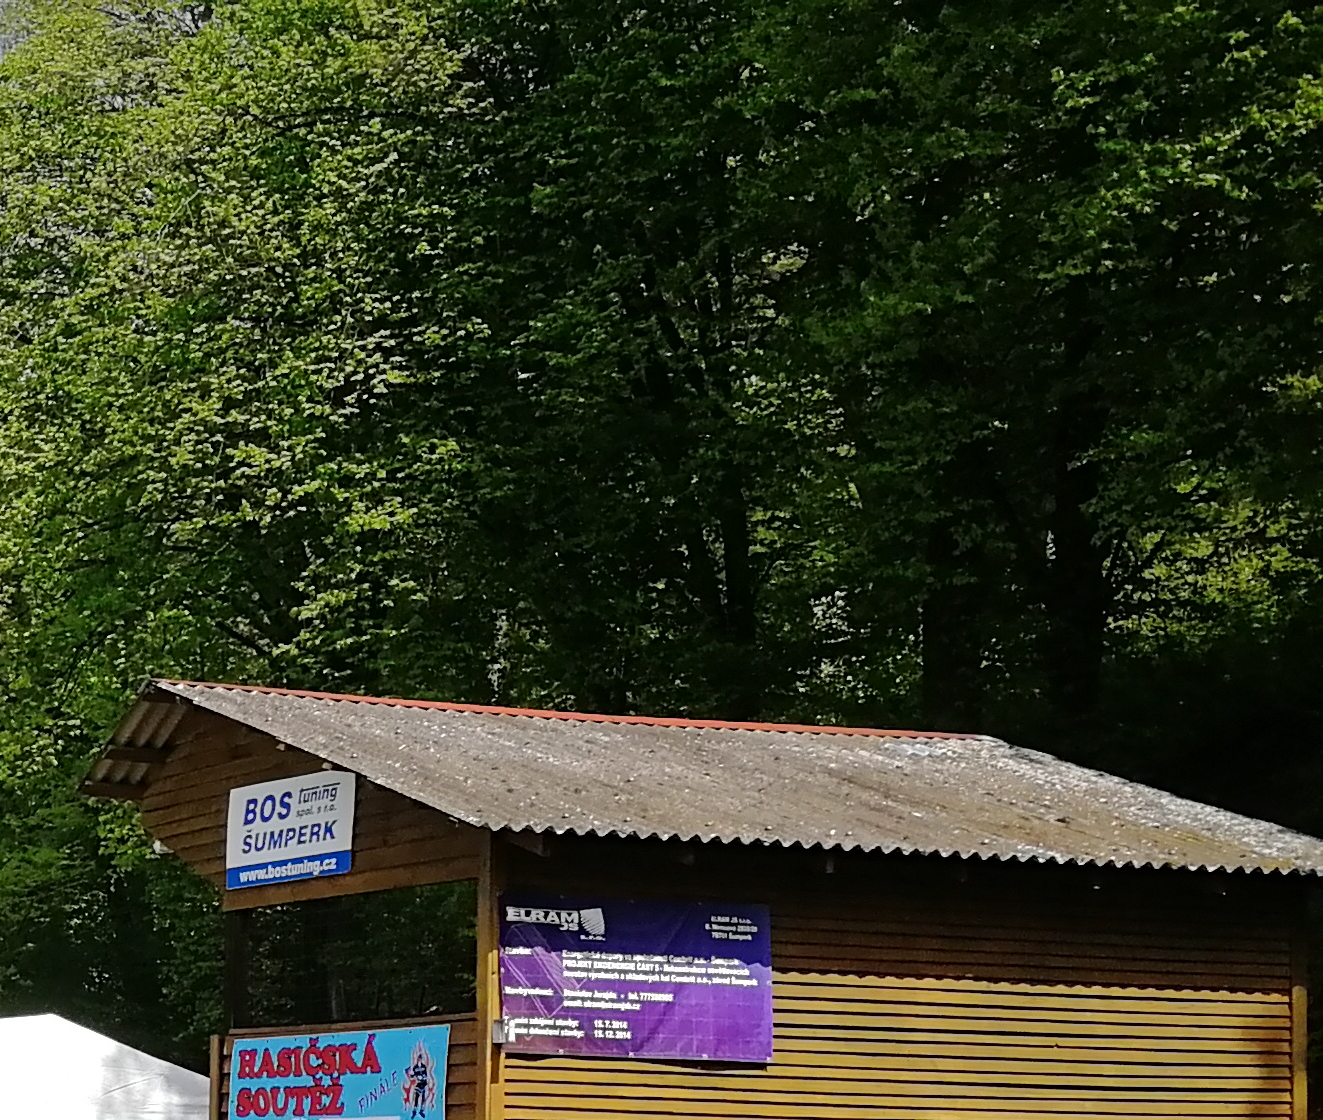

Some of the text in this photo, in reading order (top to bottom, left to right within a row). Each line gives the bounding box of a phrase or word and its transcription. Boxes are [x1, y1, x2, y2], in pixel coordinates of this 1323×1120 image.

[243, 791, 293, 826] BOS
[242, 819, 338, 854] ŠUMPERK
[239, 857, 337, 883] www.bostuning.cz
[506, 907, 579, 924] ELRAM
[559, 923, 579, 931] JS
[238, 1033, 382, 1079] HASIČSKÁ
[235, 1074, 345, 1117] SOUTĚŽ
[358, 1071, 398, 1114] FINÁLE
